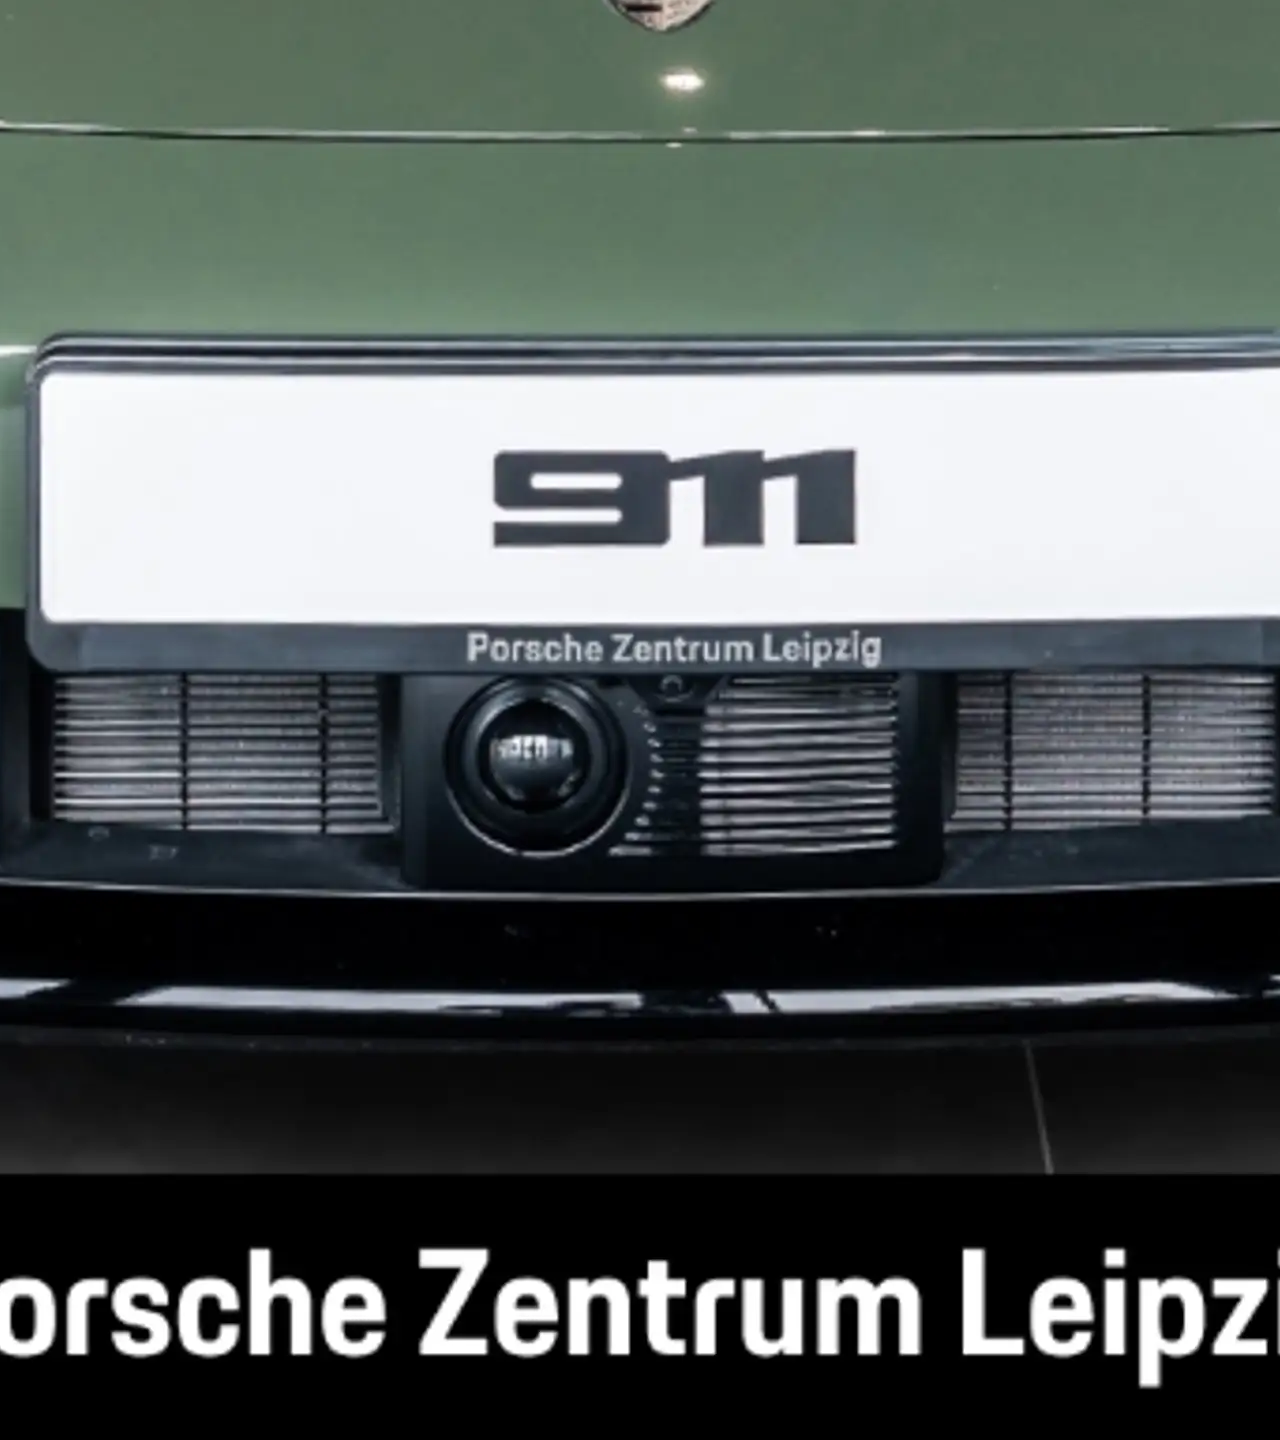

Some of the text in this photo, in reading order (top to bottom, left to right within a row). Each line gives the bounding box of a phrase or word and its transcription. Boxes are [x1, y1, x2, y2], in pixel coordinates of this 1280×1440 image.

[493, 449, 856, 547] 911
[466, 629, 883, 669] Porsche Zentrum Leipzig
